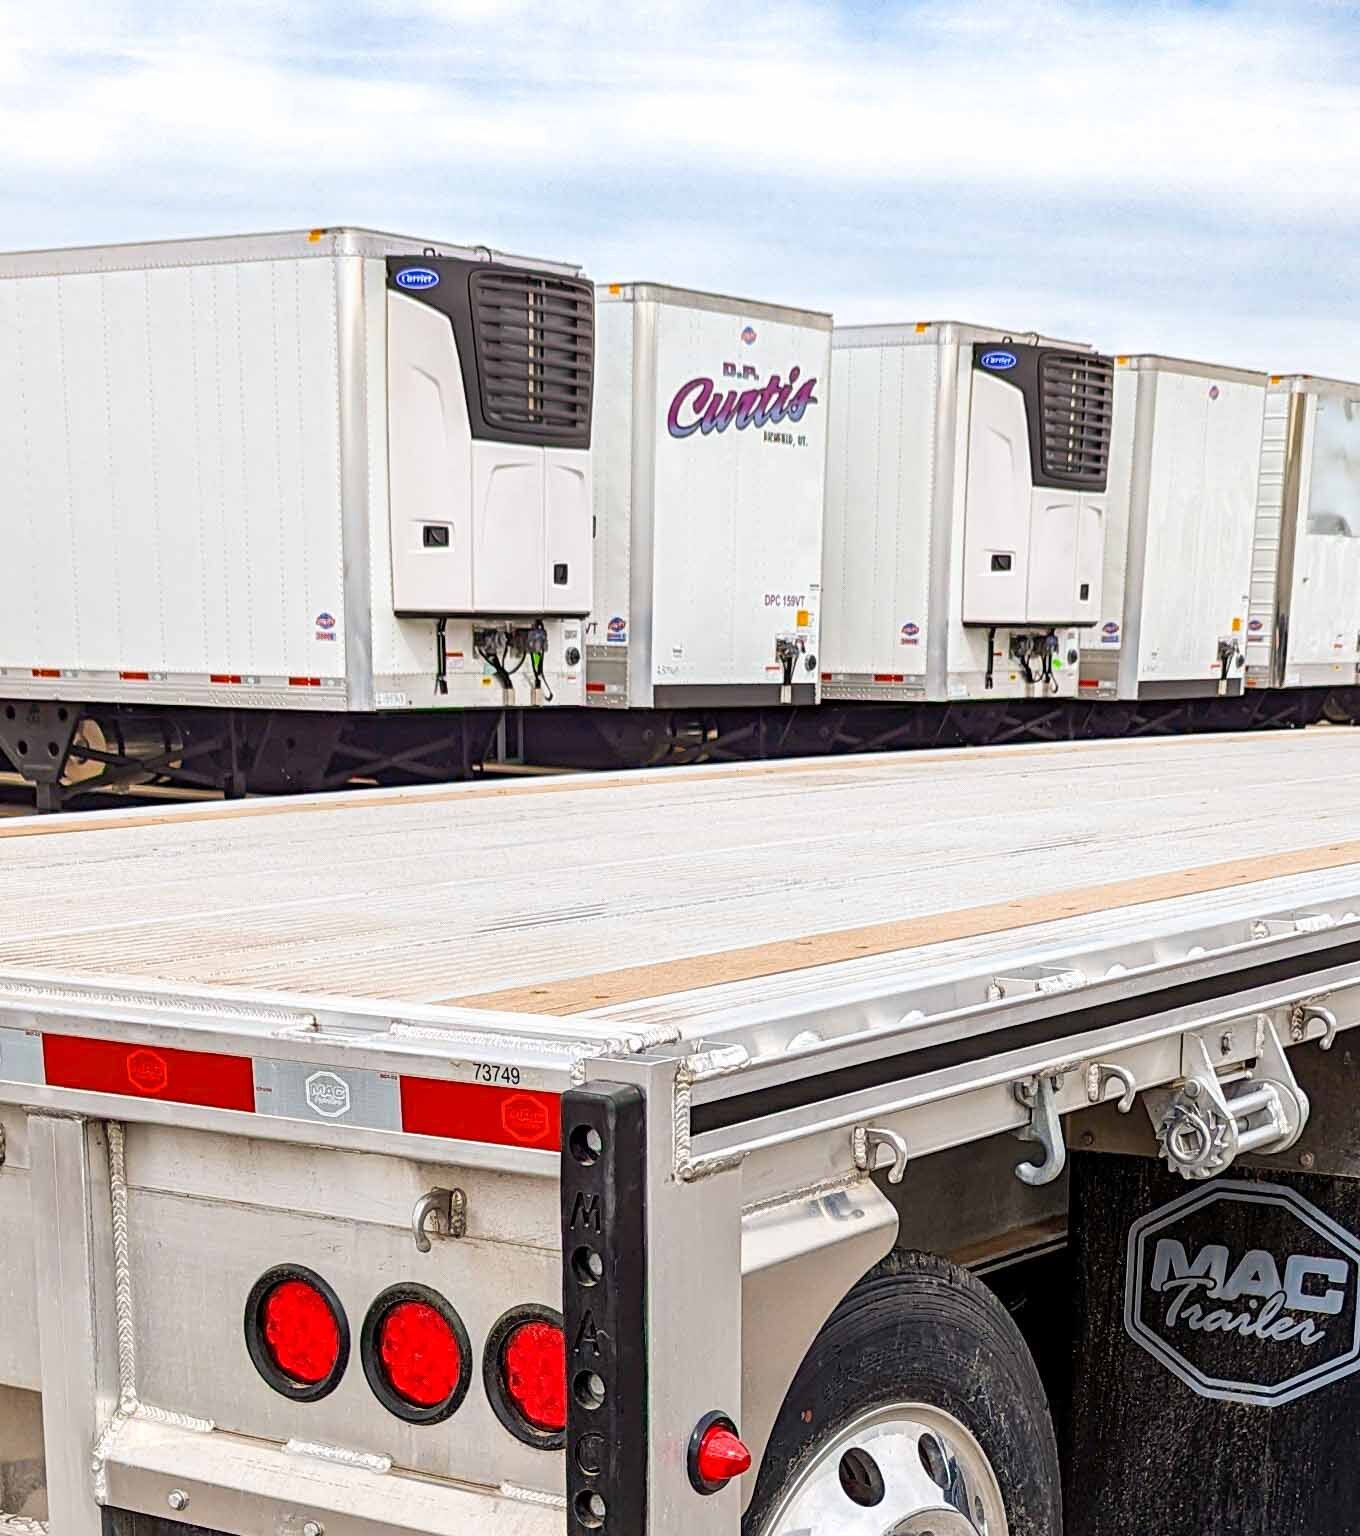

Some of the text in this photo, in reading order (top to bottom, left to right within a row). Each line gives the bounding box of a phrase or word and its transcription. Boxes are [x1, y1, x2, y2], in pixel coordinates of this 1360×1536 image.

[667, 365, 818, 439] Curtis
[764, 594, 781, 606] DPC
[310, 1082, 345, 1100] MAC
[472, 1063, 520, 1085] 73749
[1150, 1237, 1348, 1315] MAC
[1161, 1275, 1327, 1345] Trailer
